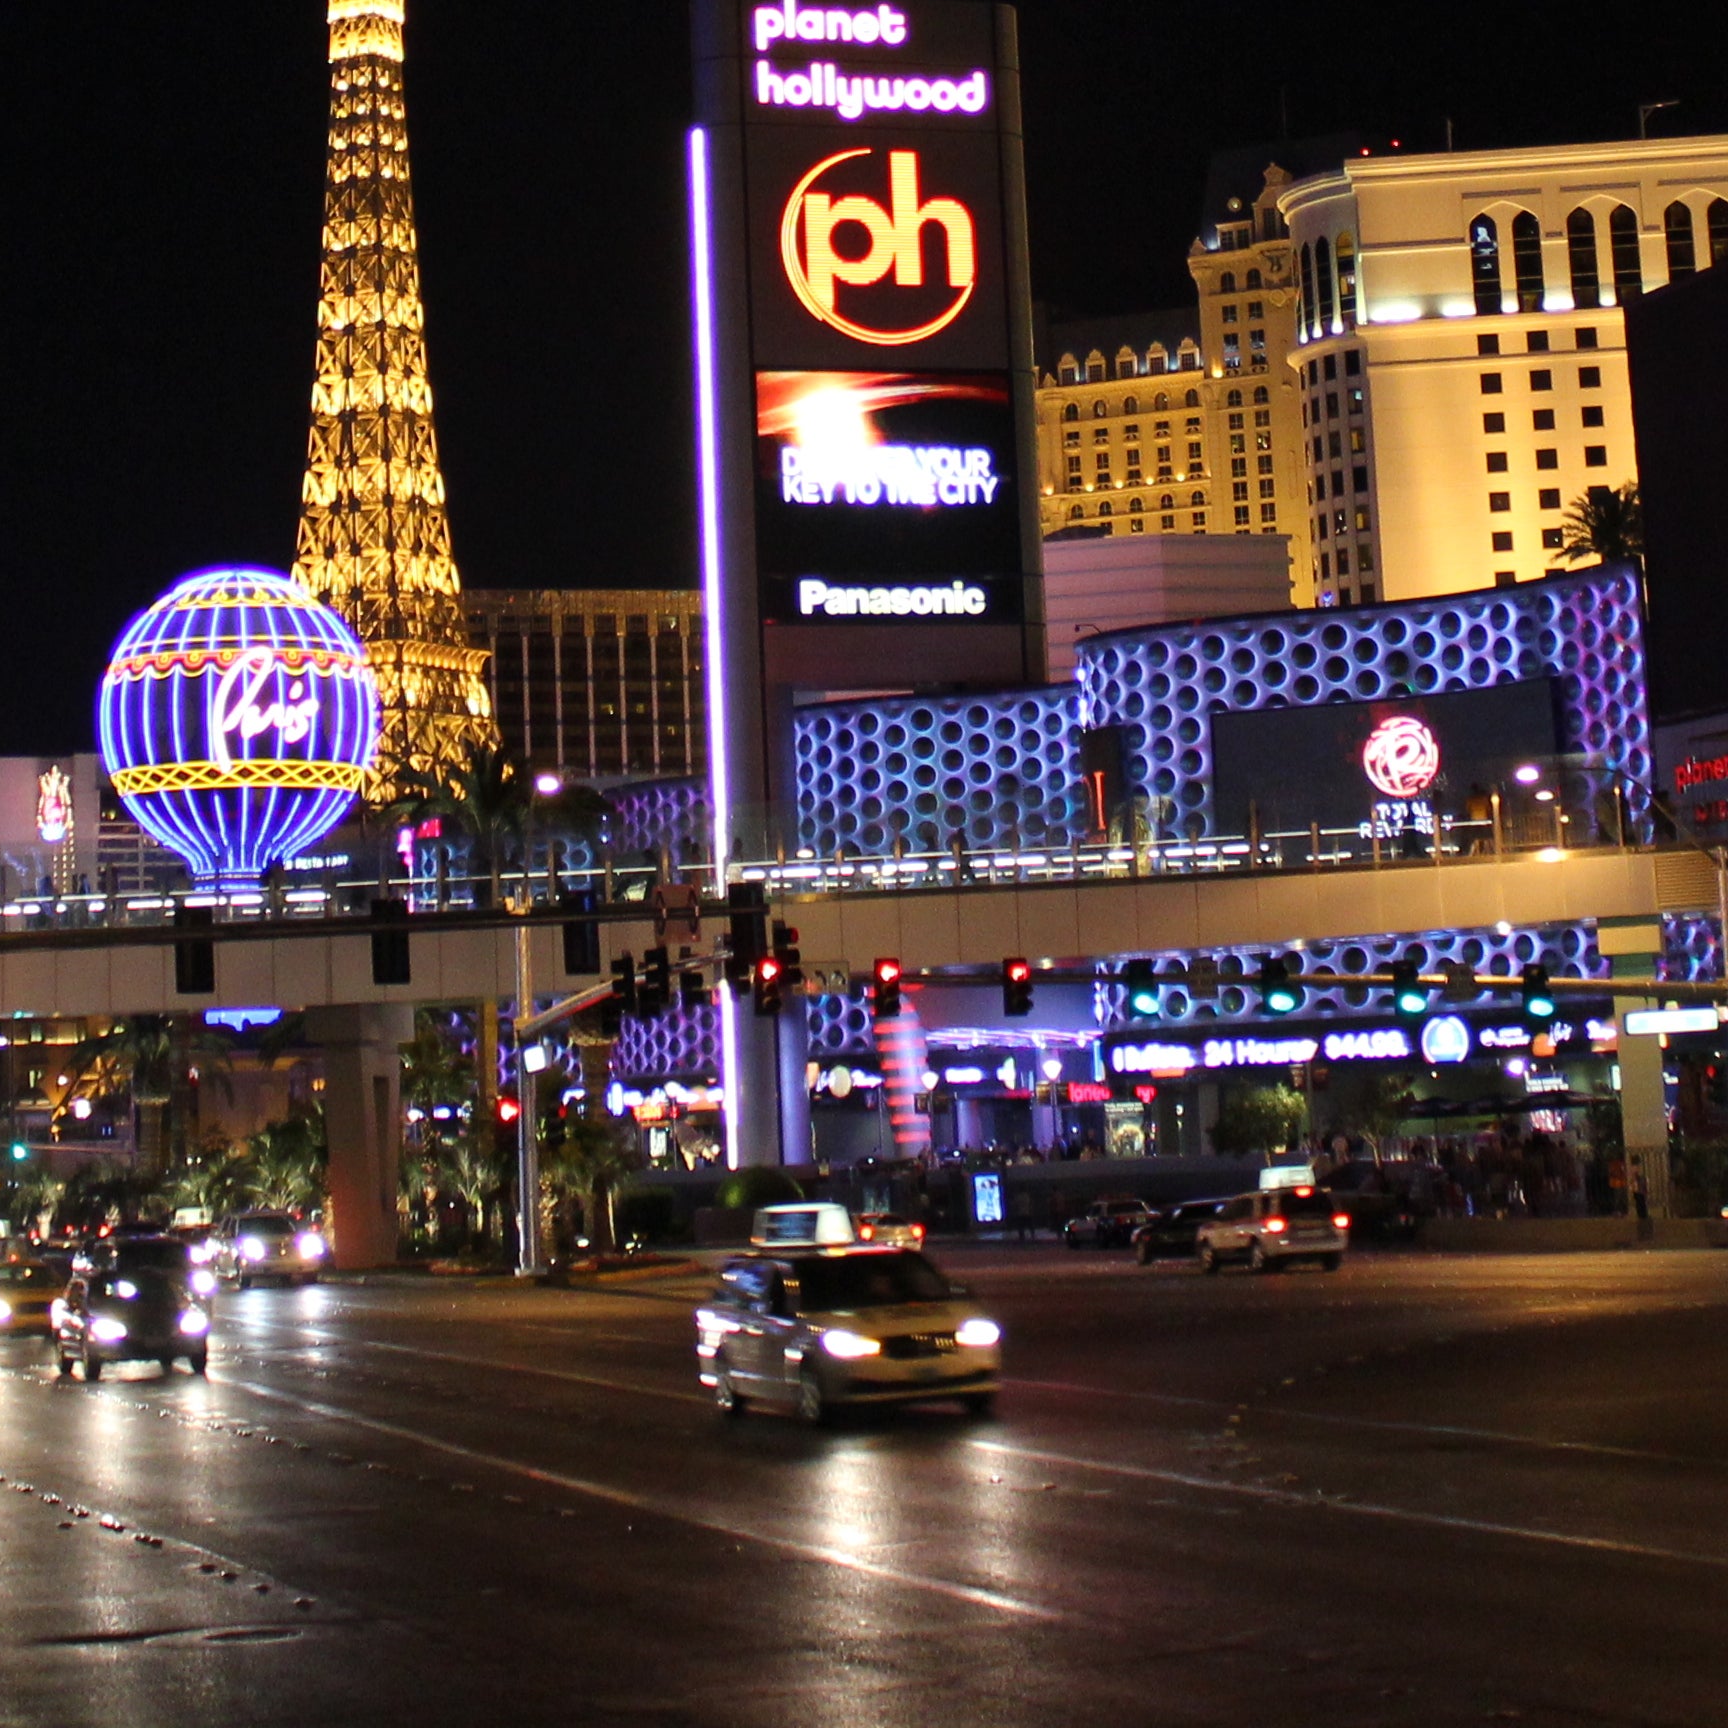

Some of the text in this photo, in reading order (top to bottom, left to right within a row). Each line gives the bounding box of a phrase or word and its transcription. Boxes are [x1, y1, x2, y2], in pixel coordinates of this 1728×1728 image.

[756, 59, 987, 119] hollywood
[803, 150, 976, 314] ph
[938, 476, 998, 505] CITY
[799, 579, 986, 615] Panasonic
[212, 645, 320, 776] Paris
